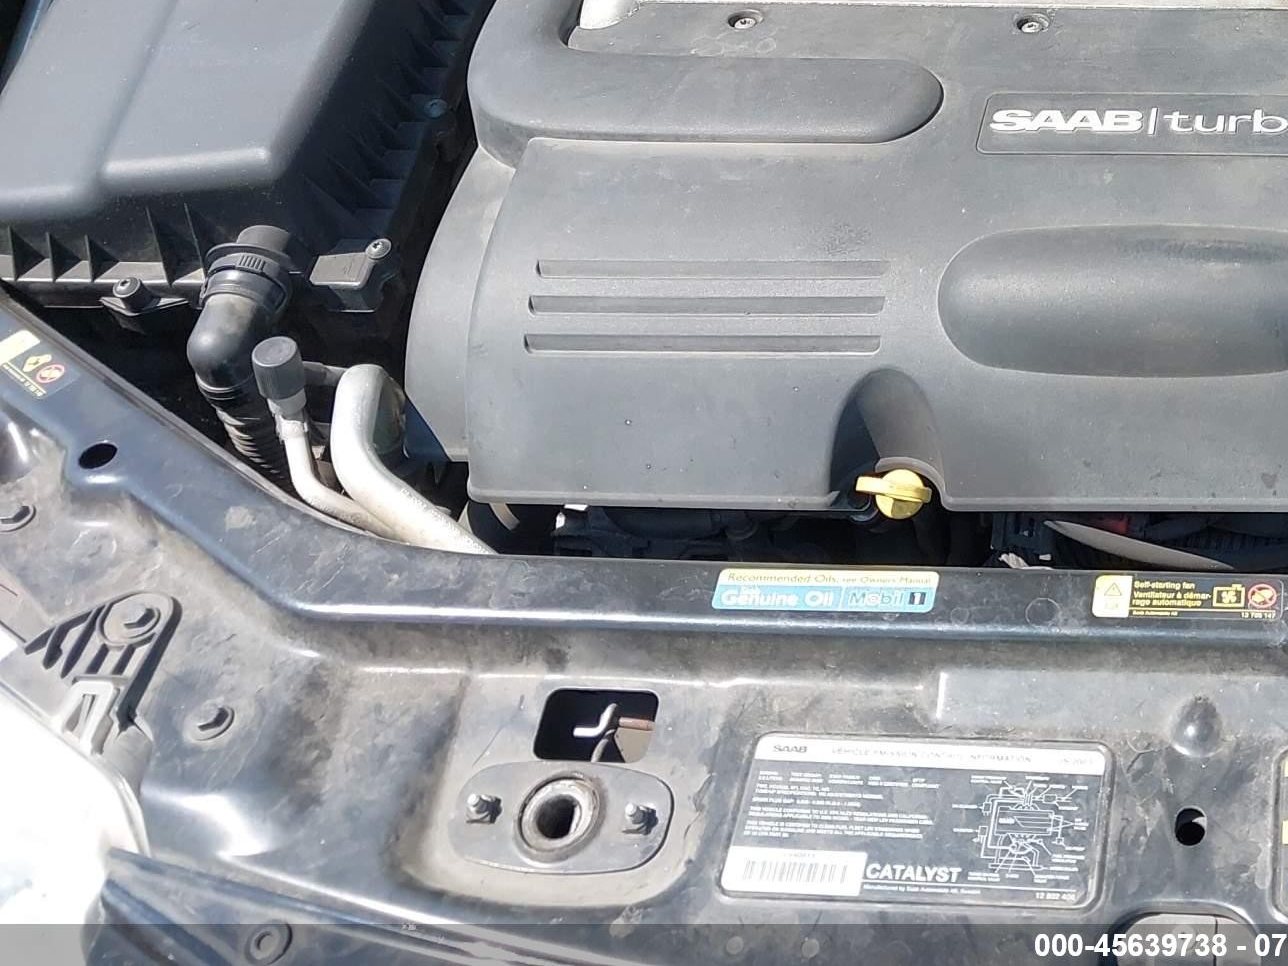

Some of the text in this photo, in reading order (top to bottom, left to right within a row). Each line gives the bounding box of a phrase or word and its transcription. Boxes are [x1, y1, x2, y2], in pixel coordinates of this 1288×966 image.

[989, 109, 1144, 132] SAAB
[728, 573, 811, 583] Recommended
[1133, 581, 1195, 590] Self-starting fan
[721, 589, 799, 607] Genuine
[805, 590, 833, 607] Oil
[847, 591, 905, 607] Mobil
[1133, 591, 1175, 599] Ventilateur
[1132, 599, 1202, 607] rage automatique
[773, 745, 808, 753] SAAB
[832, 746, 870, 756] VEHICLE
[968, 753, 1032, 762] NFORMATION
[866, 863, 962, 883] CATALYST
